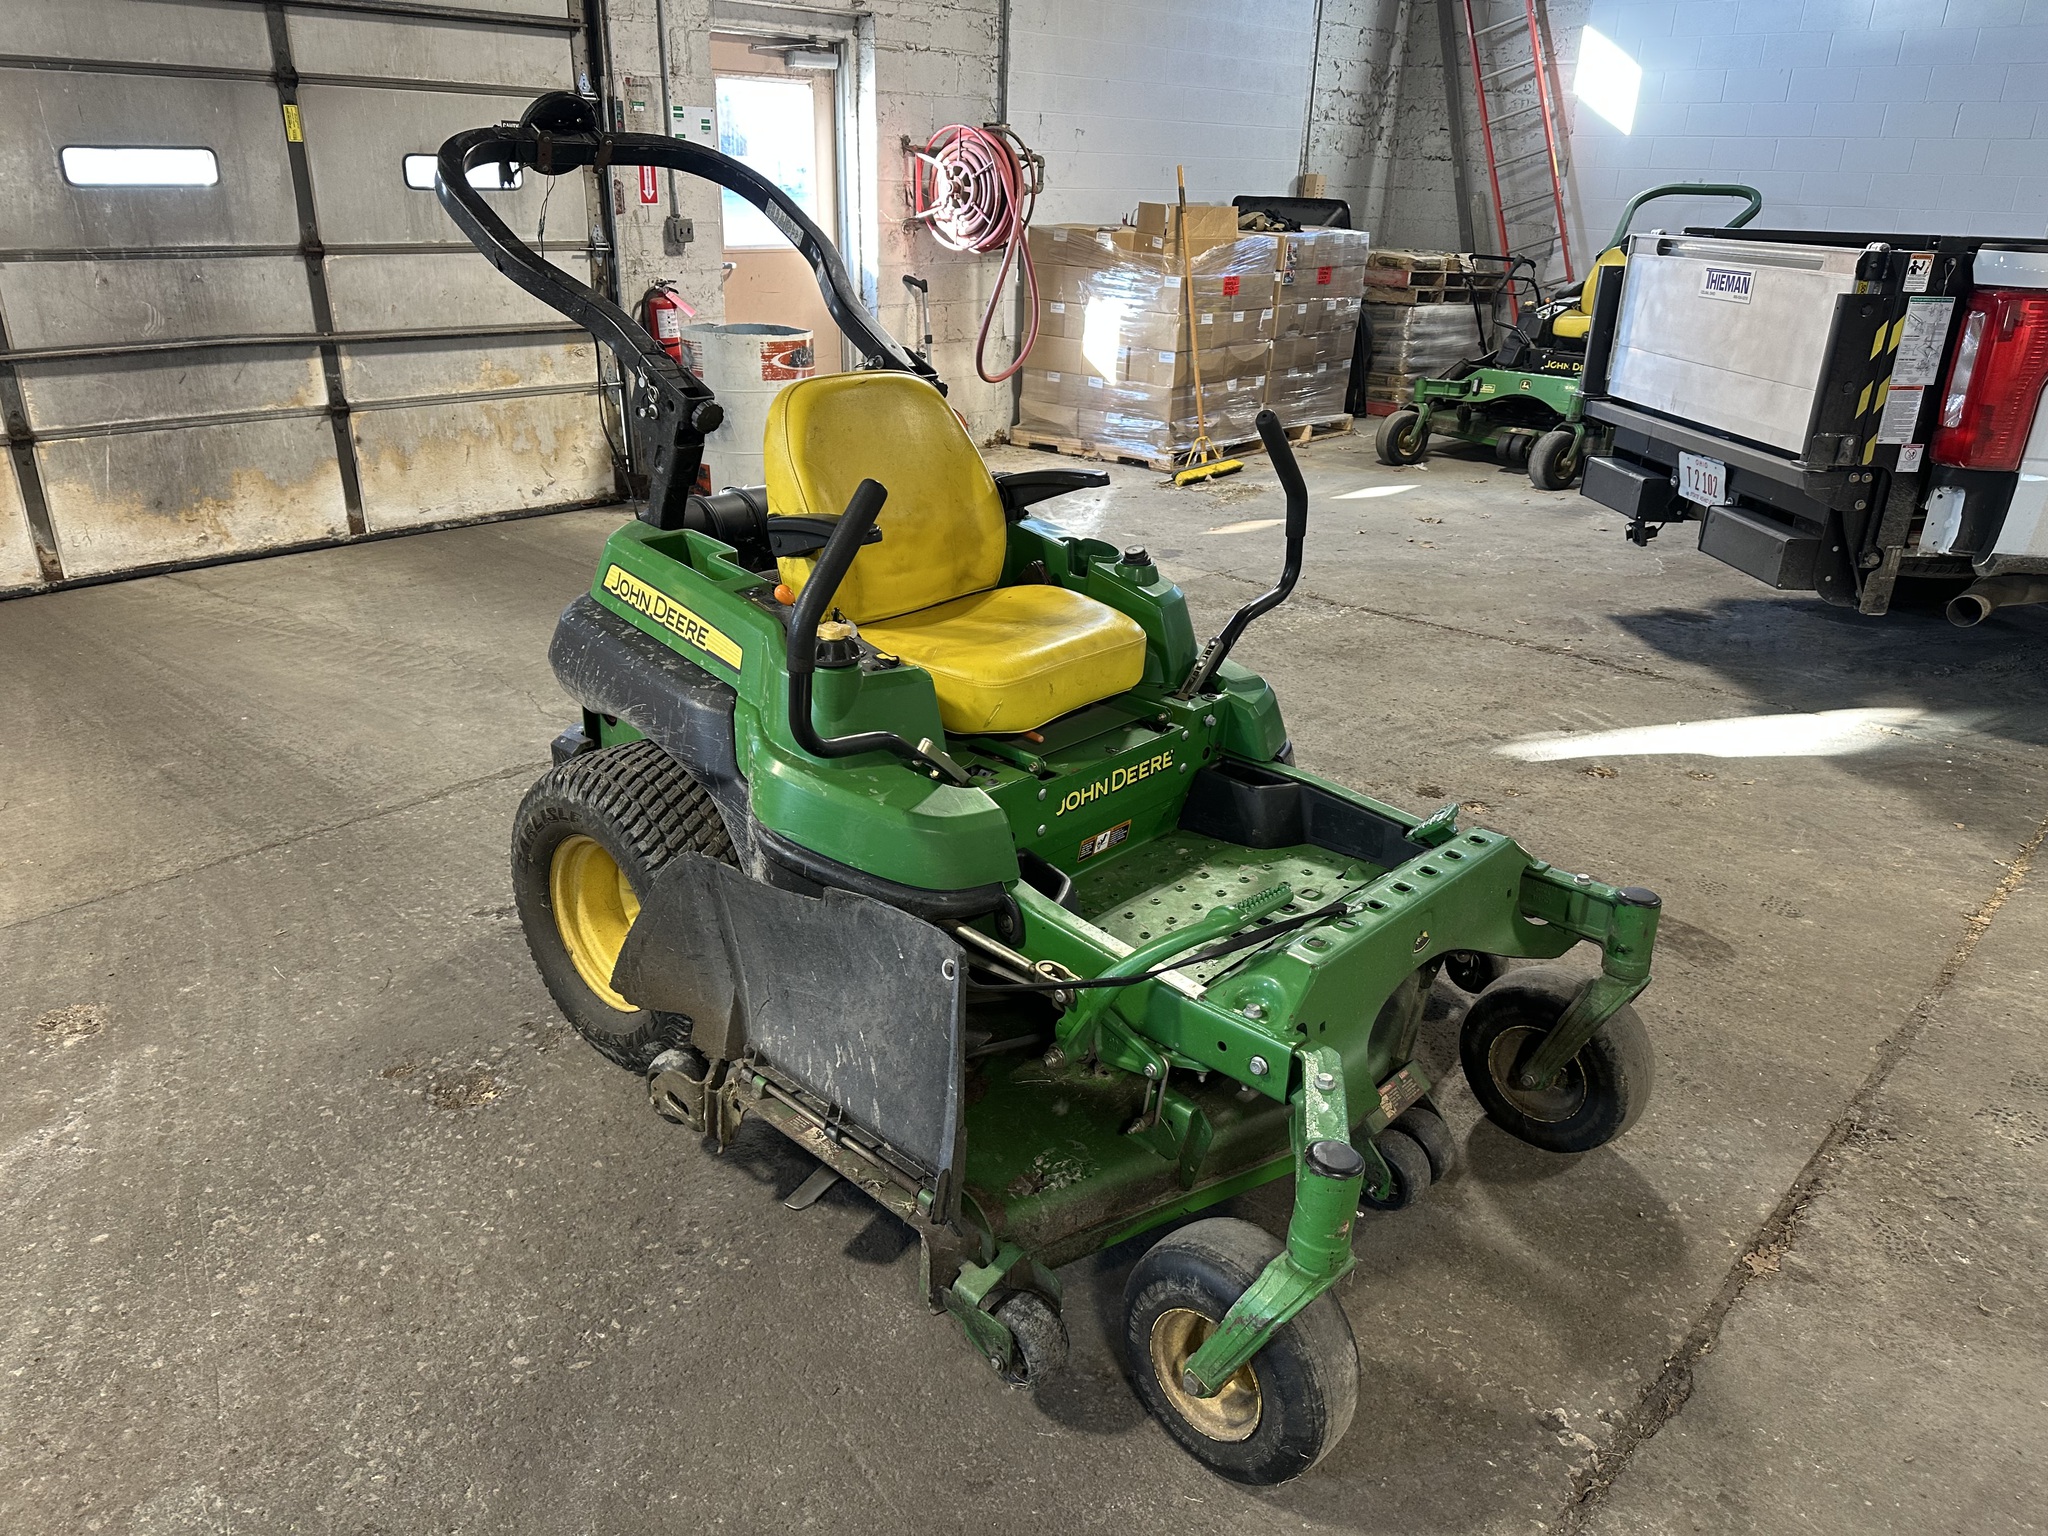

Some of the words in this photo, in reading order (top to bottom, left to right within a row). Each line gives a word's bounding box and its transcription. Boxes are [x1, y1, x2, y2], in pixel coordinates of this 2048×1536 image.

[1706, 268, 1751, 294] THIEMAN
[1544, 360, 1570, 370] JOHN
[1695, 459, 1708, 468] OHIO
[611, 572, 652, 612] JOHN
[653, 596, 710, 647] DEERE
[1056, 777, 1109, 817] JOHN
[1111, 750, 1173, 792] DEERE
